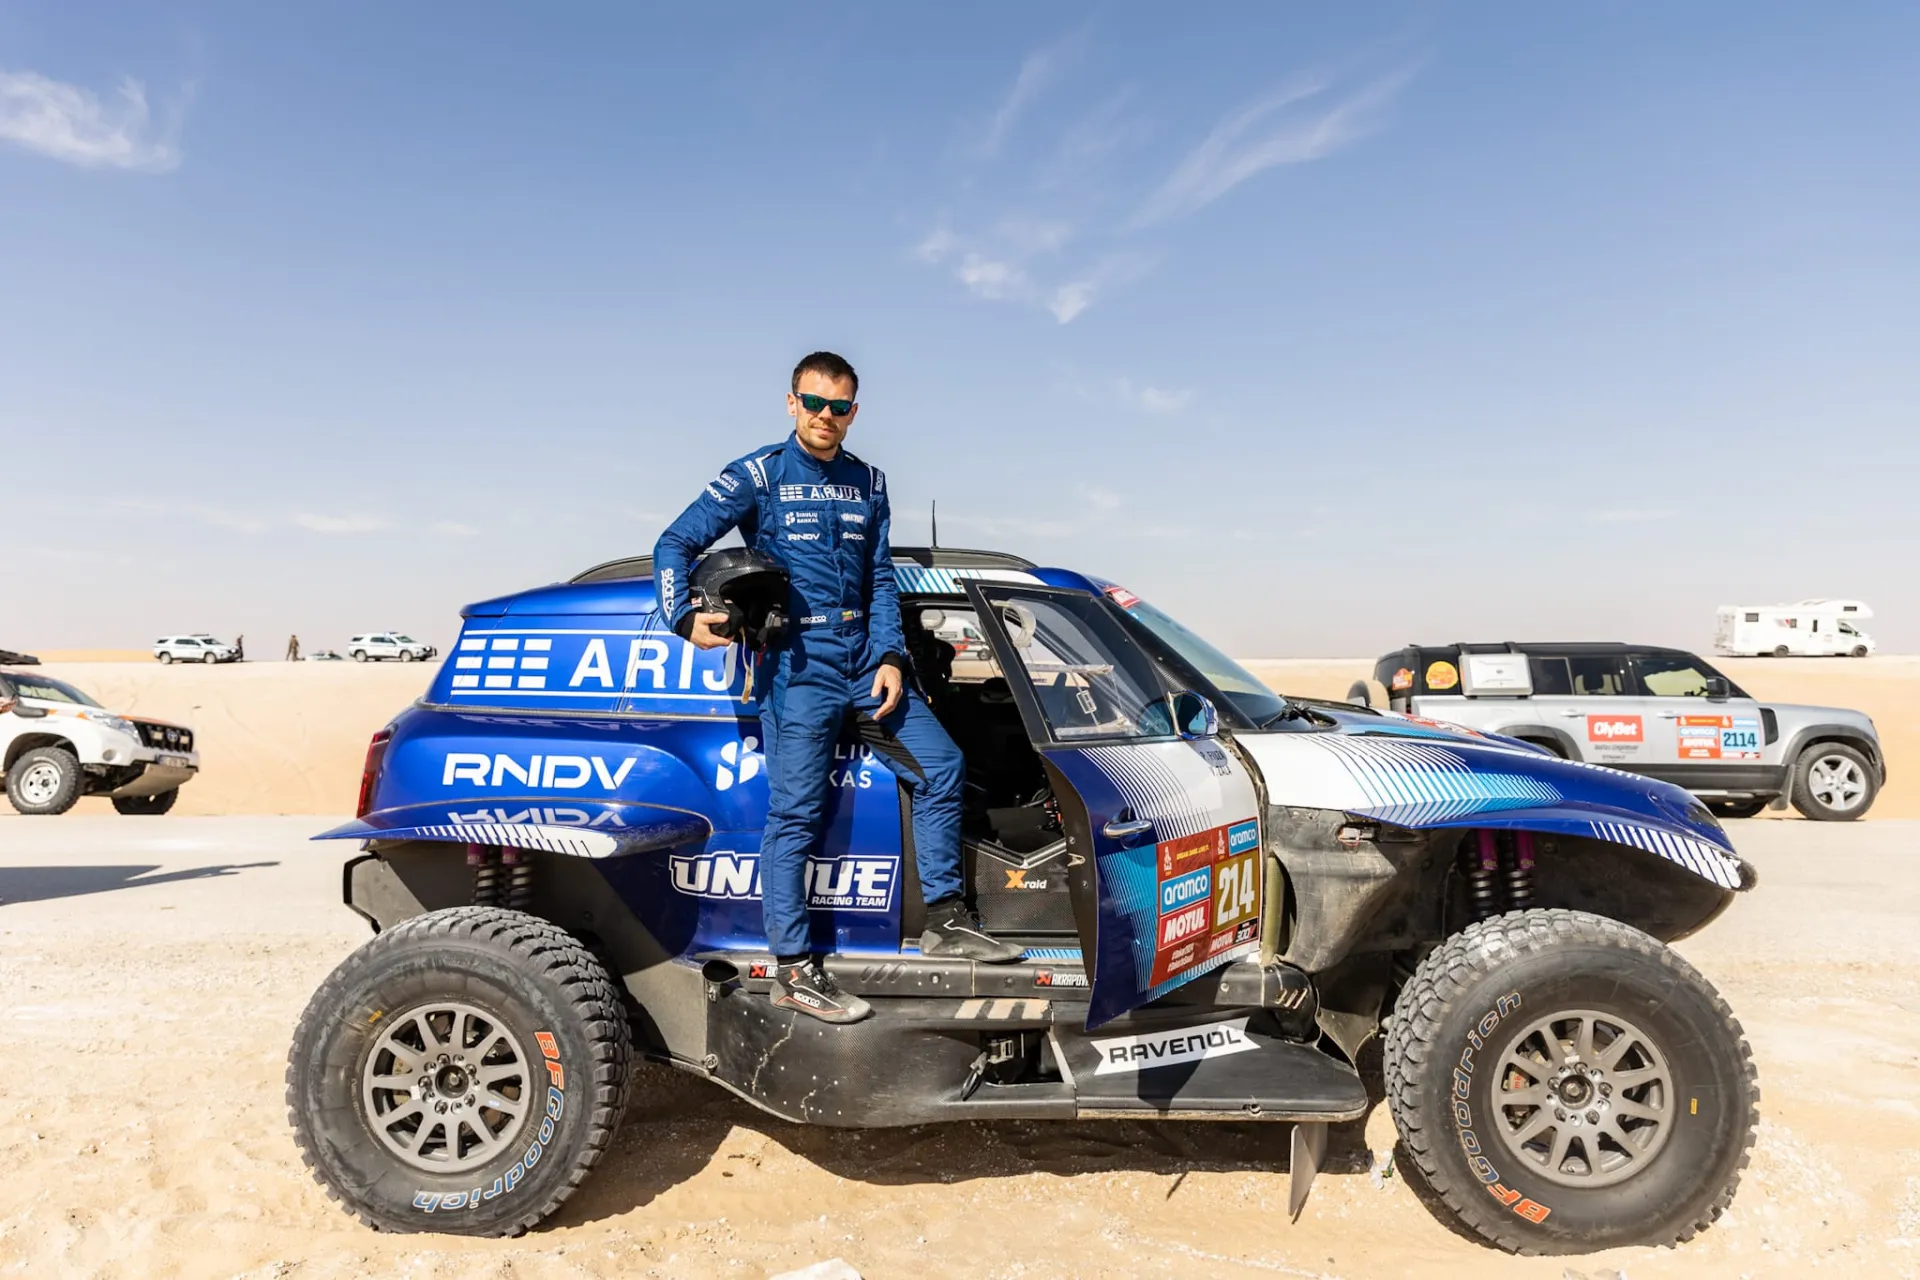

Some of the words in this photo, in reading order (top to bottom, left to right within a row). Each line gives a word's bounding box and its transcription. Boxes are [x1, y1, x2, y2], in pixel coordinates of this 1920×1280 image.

[810, 485, 862, 500] ARIJUS
[787, 533, 820, 541] RNDV
[568, 638, 738, 691] ARIJ
[1593, 720, 1638, 739] OlyBet
[1723, 732, 1757, 747] 2114
[442, 753, 638, 790] RNDV
[1230, 828, 1257, 846] aramco
[811, 896, 853, 906] RACING
[855, 897, 887, 907] TEAM
[1164, 874, 1207, 905] aramco
[1216, 858, 1254, 927] 214
[1163, 906, 1205, 944] MOTUL
[1210, 931, 1234, 953] MOTUL
[1051, 973, 1090, 987] AKRAPOV
[1109, 1029, 1242, 1064] RAVENOL
[1453, 990, 1553, 1225] BFGoodrich
[413, 1030, 565, 1213] BFGoodrich
